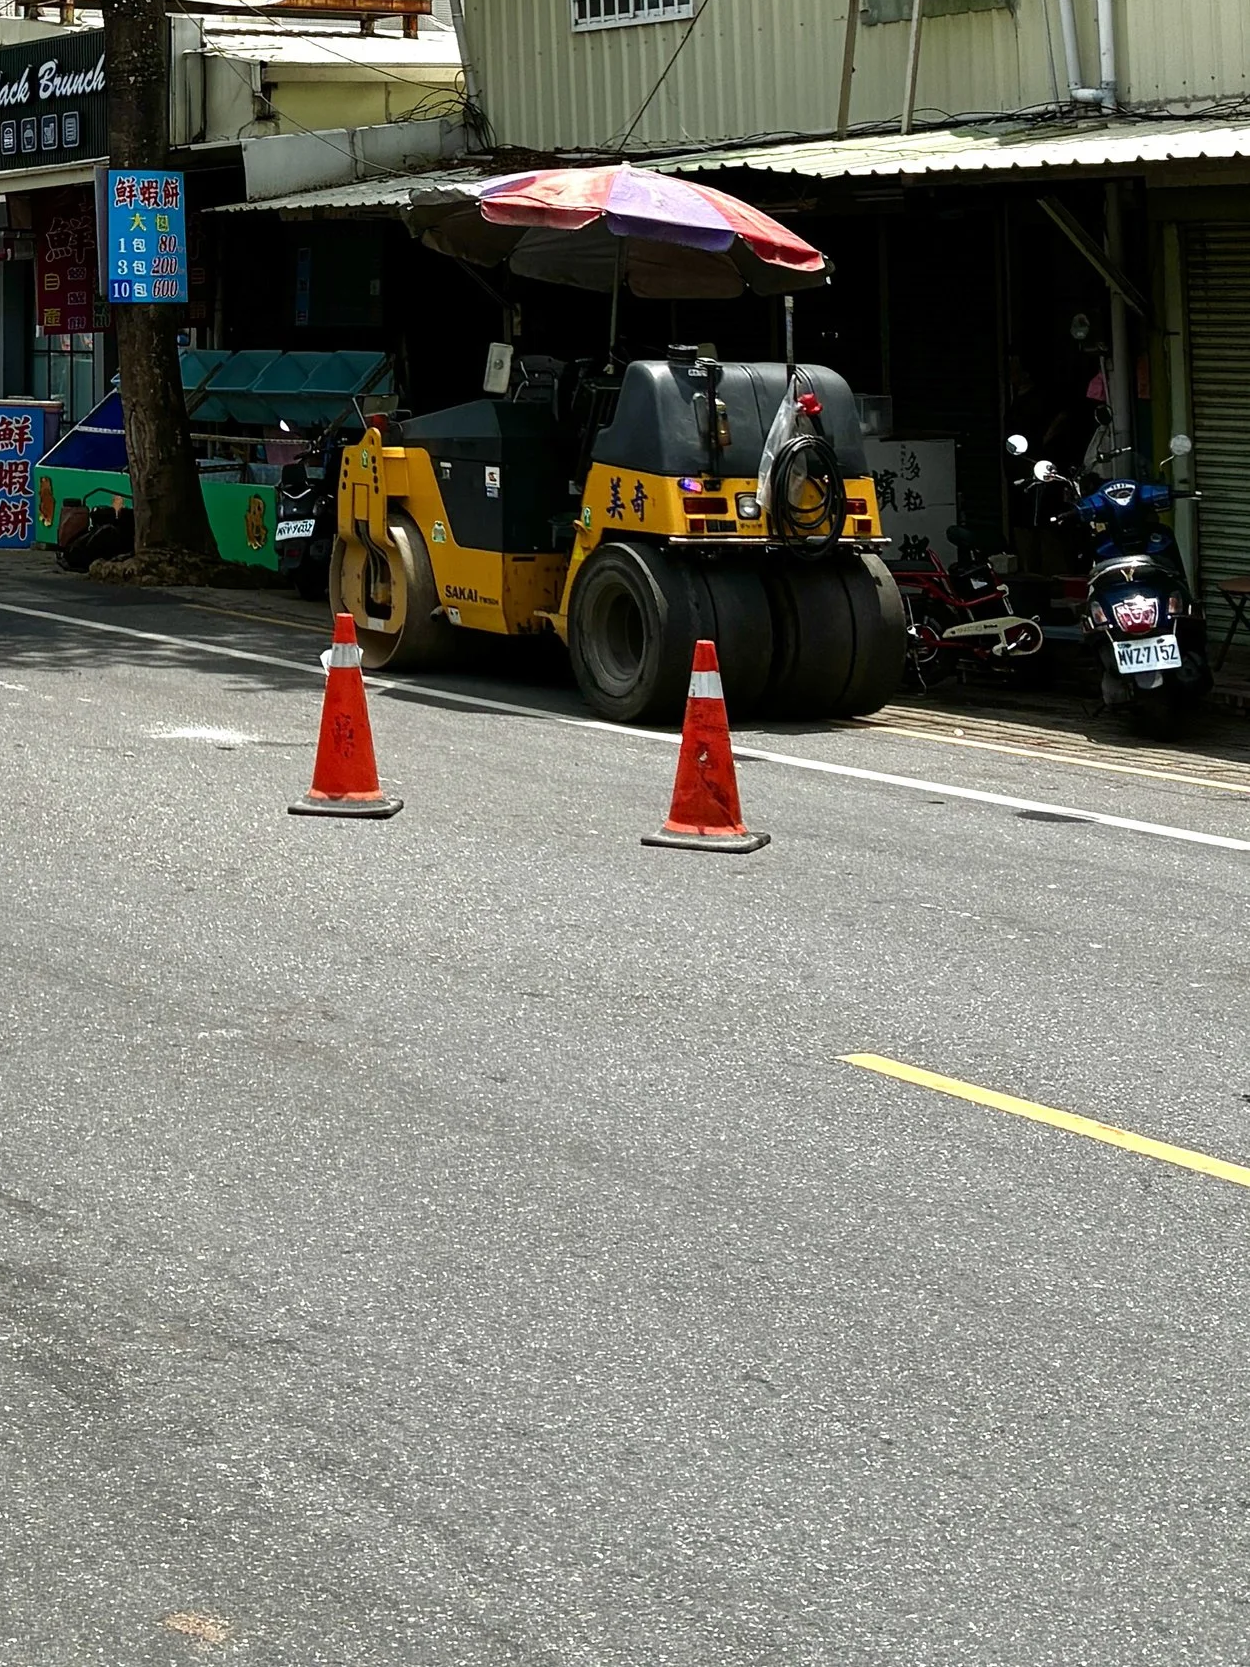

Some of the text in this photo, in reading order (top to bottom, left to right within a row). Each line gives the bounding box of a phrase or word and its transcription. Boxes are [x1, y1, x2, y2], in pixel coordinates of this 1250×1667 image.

[37, 50, 106, 100] Brunch
[114, 176, 181, 210] 鮮蝦餅
[158, 234, 178, 254] 80
[150, 255, 179, 276] 200
[152, 278, 180, 298] 600
[605, 476, 648, 523] 美奇
[444, 584, 478, 604] SAKAI
